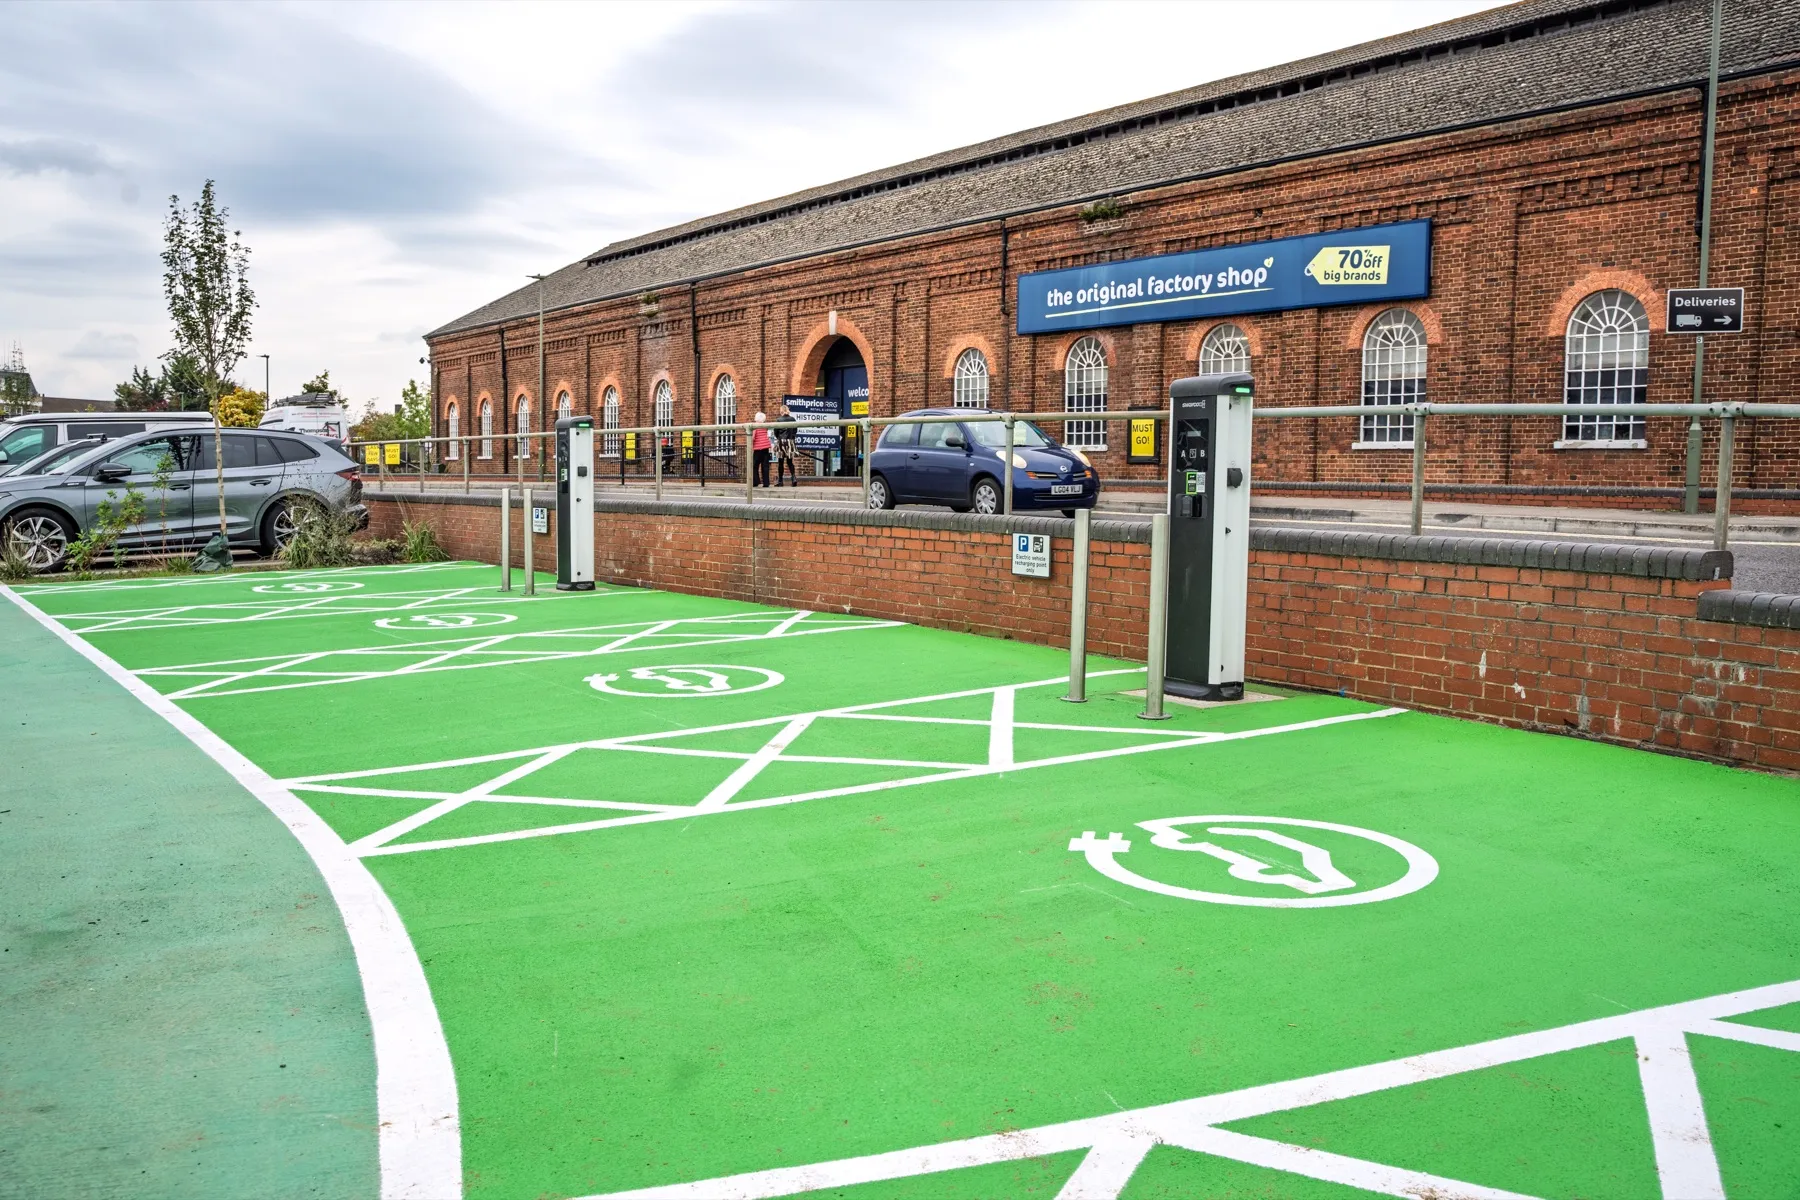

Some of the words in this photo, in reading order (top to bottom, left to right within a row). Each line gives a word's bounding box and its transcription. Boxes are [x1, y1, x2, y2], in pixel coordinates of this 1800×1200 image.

[1363, 256, 1383, 268] off
[1323, 270, 1341, 282] big
[1343, 270, 1381, 281] brands
[1047, 288, 1073, 307] the
[1076, 277, 1144, 305] original
[1147, 273, 1213, 294] factory
[1217, 266, 1268, 288] shop
[1675, 296, 1736, 307] Deliveries
[848, 386, 868, 398] welco
[786, 399, 824, 408] smithprice
[1132, 424, 1153, 432] MUST
[1136, 436, 1150, 444] GO!
